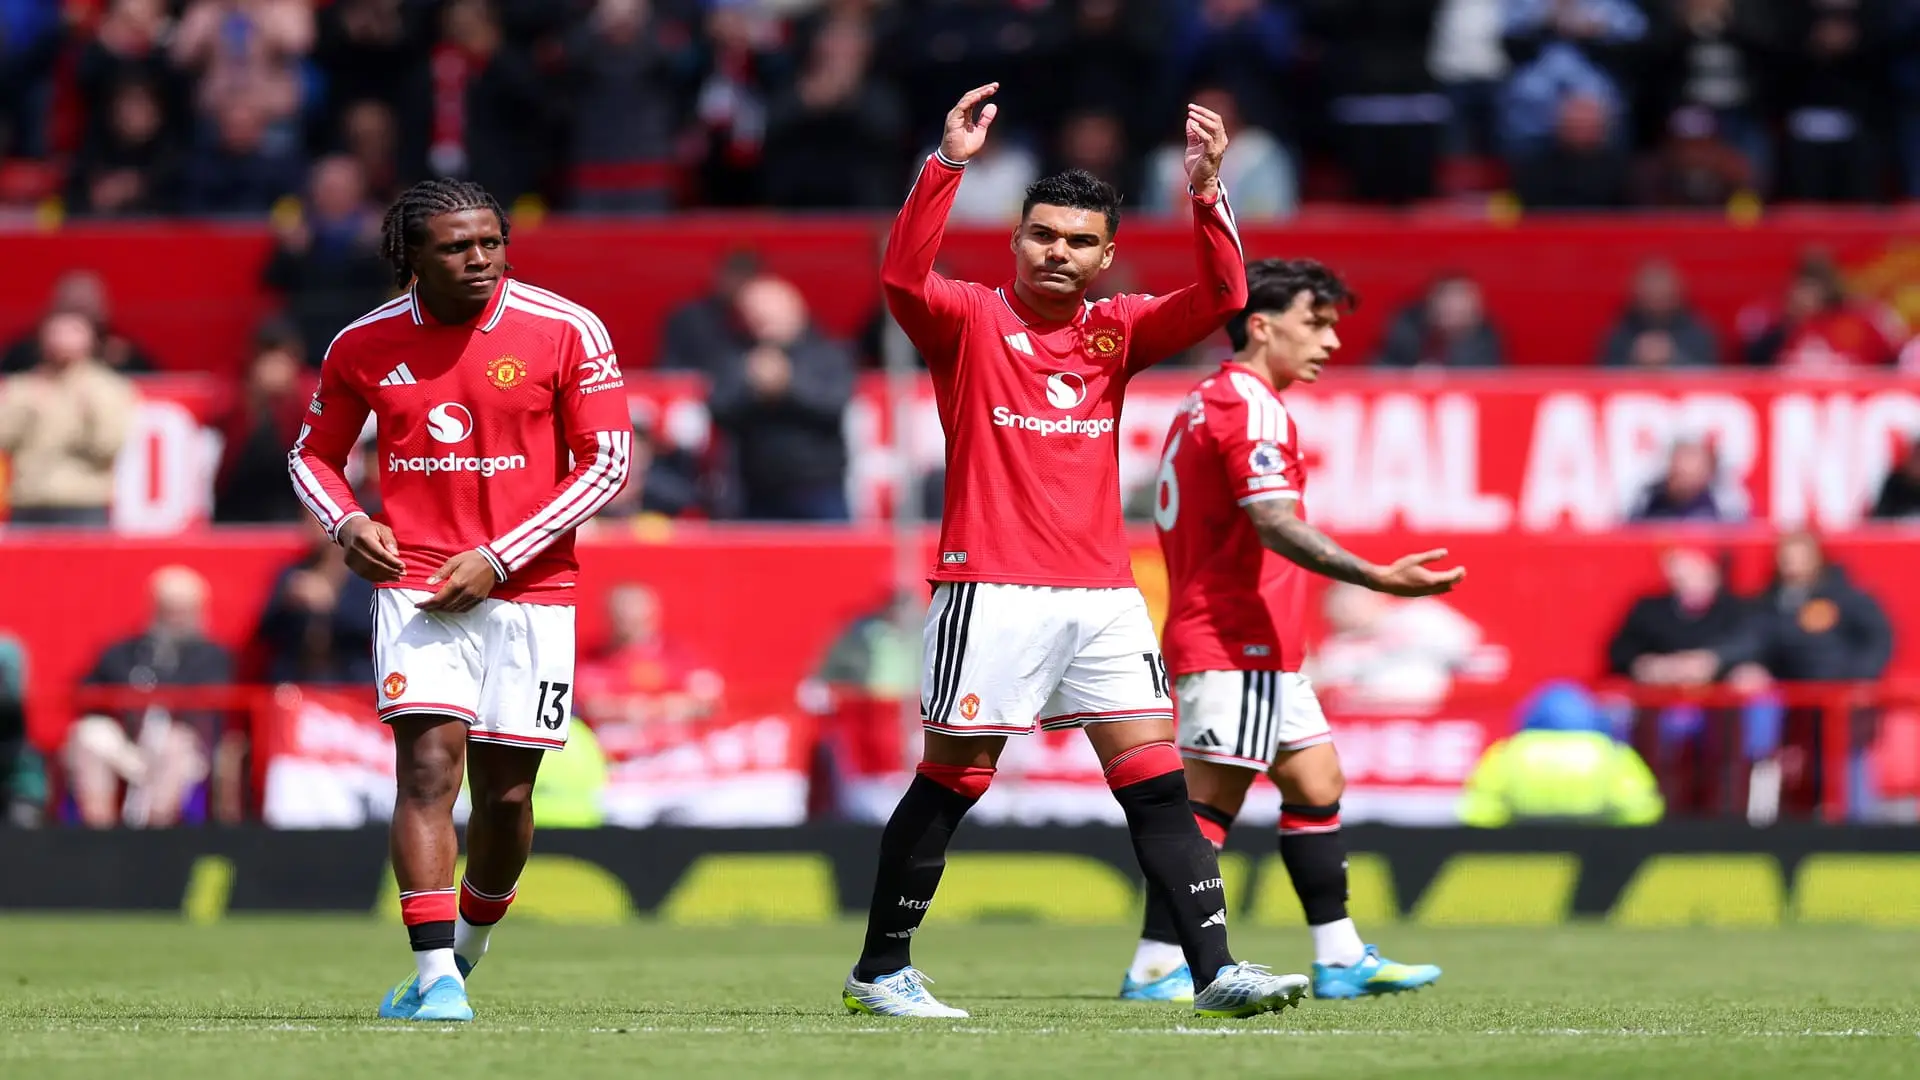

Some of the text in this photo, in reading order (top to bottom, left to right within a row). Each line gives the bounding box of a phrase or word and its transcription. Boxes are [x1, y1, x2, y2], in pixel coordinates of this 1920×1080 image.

[388, 452, 526, 477] Snapdragon
[1154, 428, 1181, 532] 6
[536, 680, 569, 730] 13
